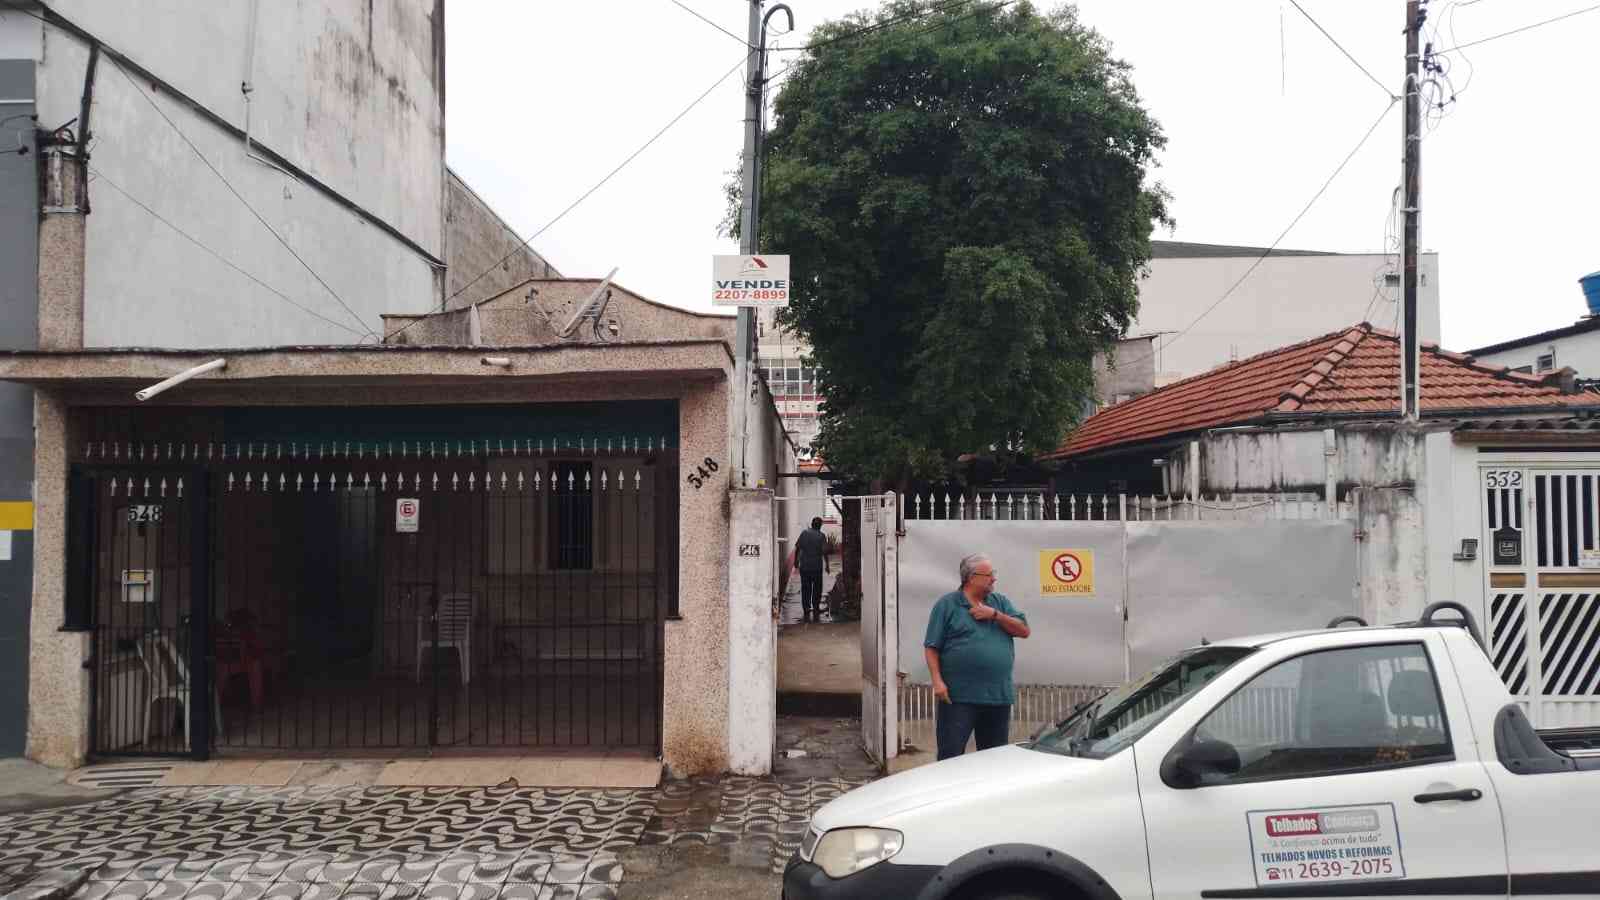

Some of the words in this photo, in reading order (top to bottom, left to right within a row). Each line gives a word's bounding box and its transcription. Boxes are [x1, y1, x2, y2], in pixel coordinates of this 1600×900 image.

[716, 280, 786, 289] VENDE
[715, 290, 786, 299] 2207-8899
[687, 457, 719, 489] 548
[1487, 471, 1522, 487] 532
[129, 505, 161, 521] 548
[1270, 817, 1318, 833] Telhados
[1261, 850, 1305, 863] TELHADOS
[1307, 849, 1337, 861] NOVOS
[1339, 848, 1345, 859] E
[1346, 846, 1392, 858] REFORMAS
[1282, 868, 1294, 880] 11
[1298, 858, 1393, 879] 2639-2075
